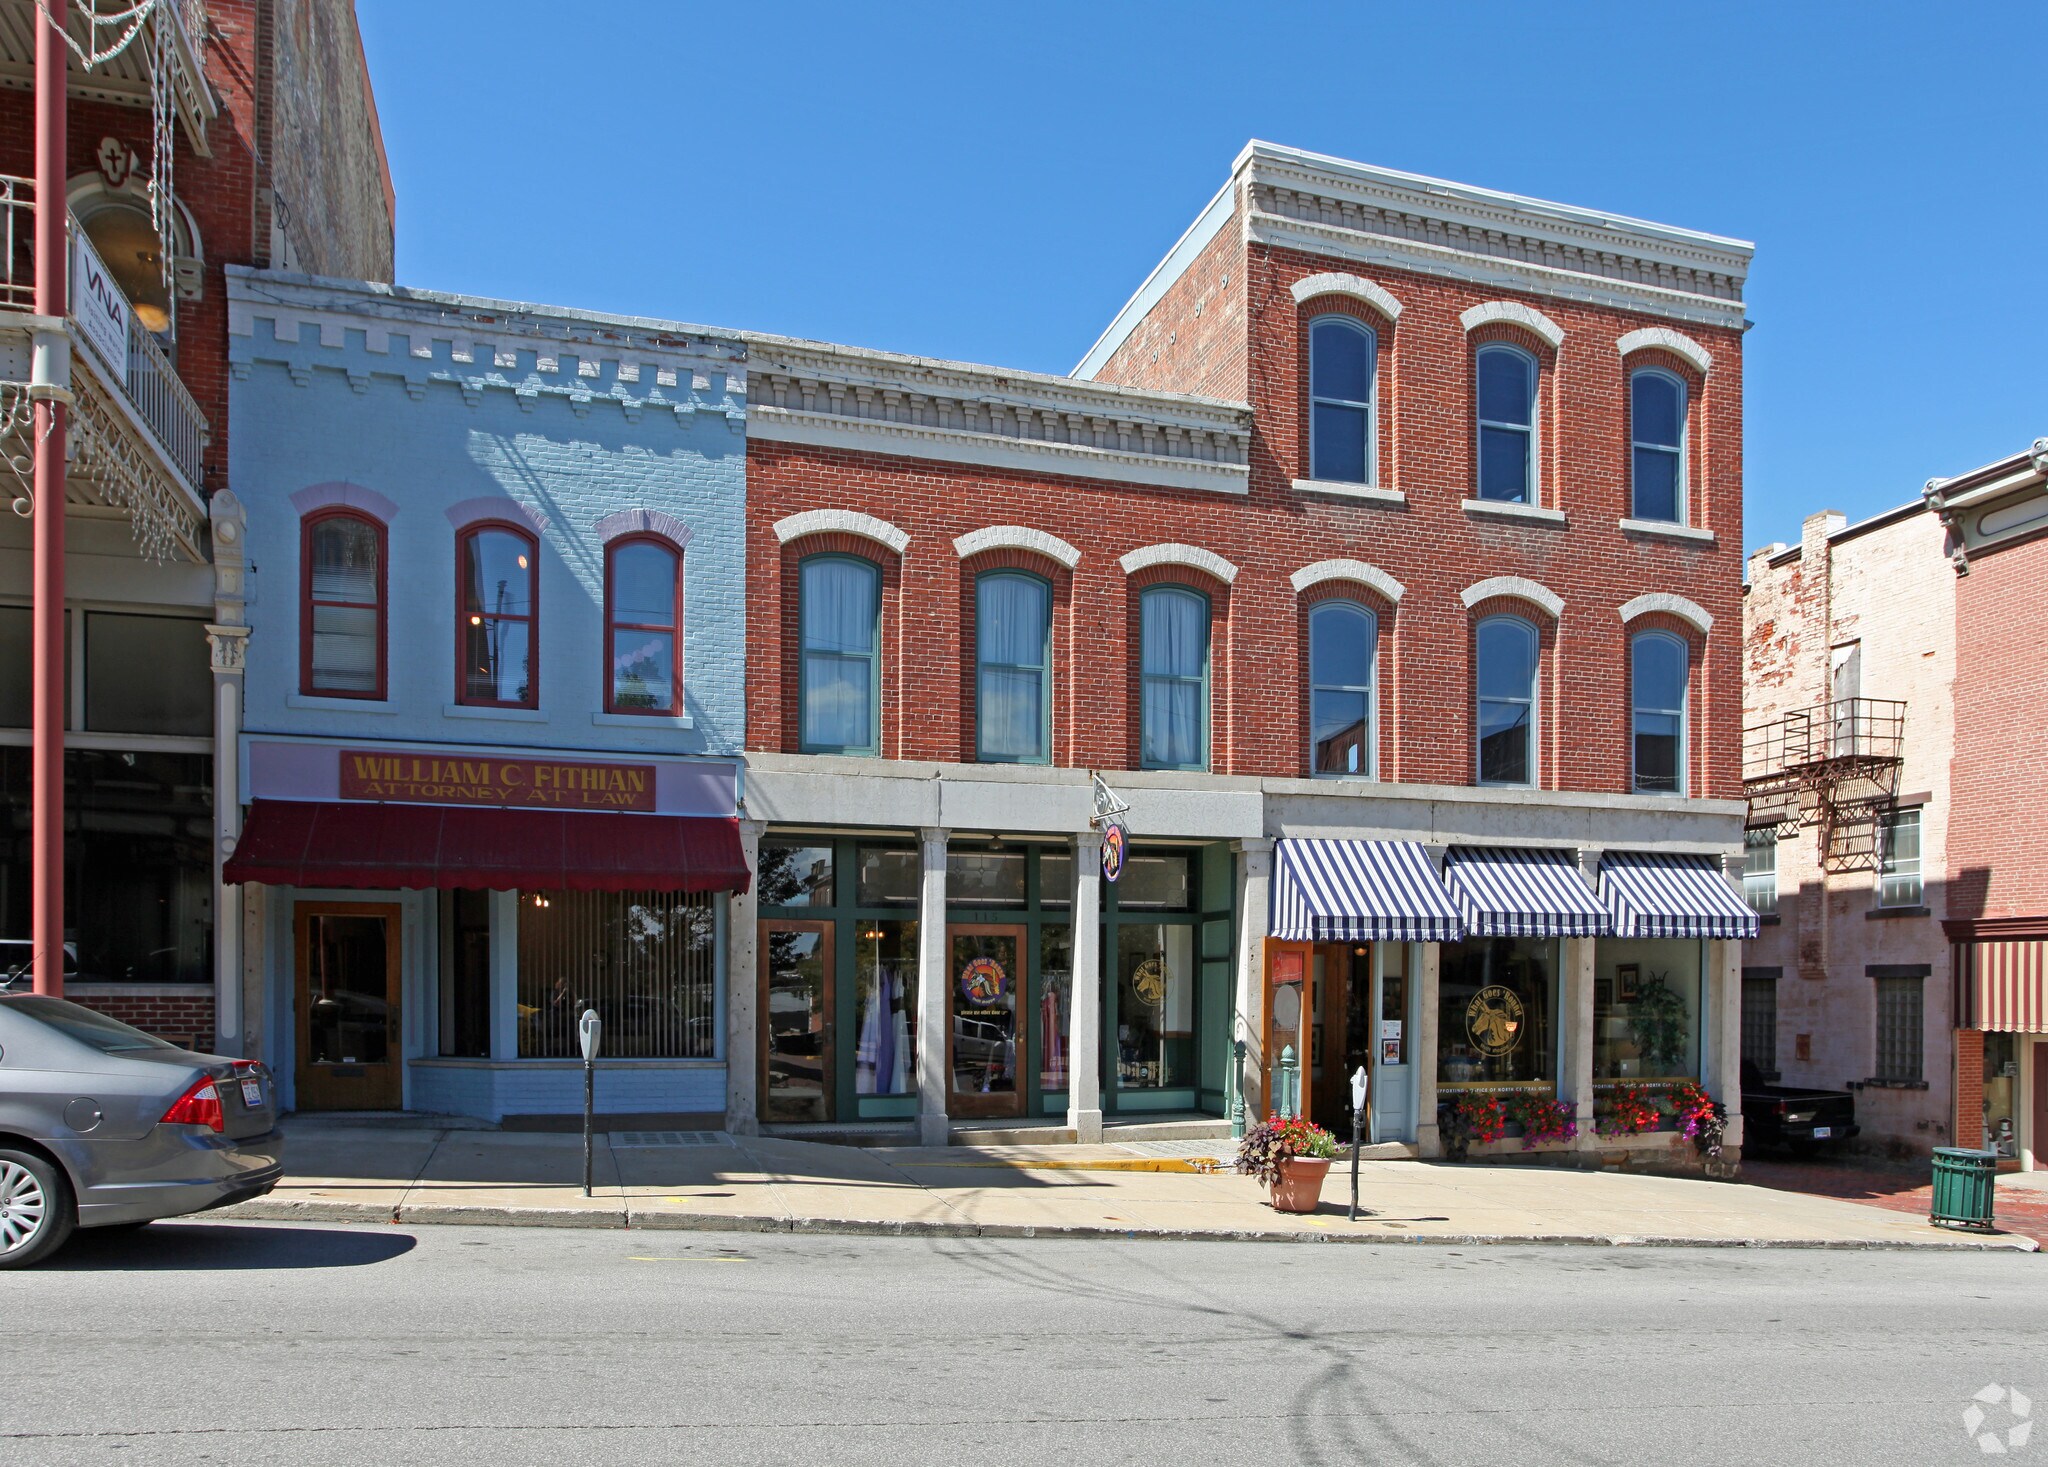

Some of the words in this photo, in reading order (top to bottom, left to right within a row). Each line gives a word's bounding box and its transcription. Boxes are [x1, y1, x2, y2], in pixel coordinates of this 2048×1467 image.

[84, 253, 125, 338] VNA
[353, 756, 490, 784] WILLIAM
[500, 763, 527, 787] C.
[534, 765, 645, 792] FITHIAN
[363, 782, 513, 801] ATTORNEY
[526, 788, 568, 802] AT
[583, 791, 637, 805] LAW
[975, 911, 998, 921] 115
[1468, 996, 1484, 1017] What
[1482, 988, 1501, 999] Goes
